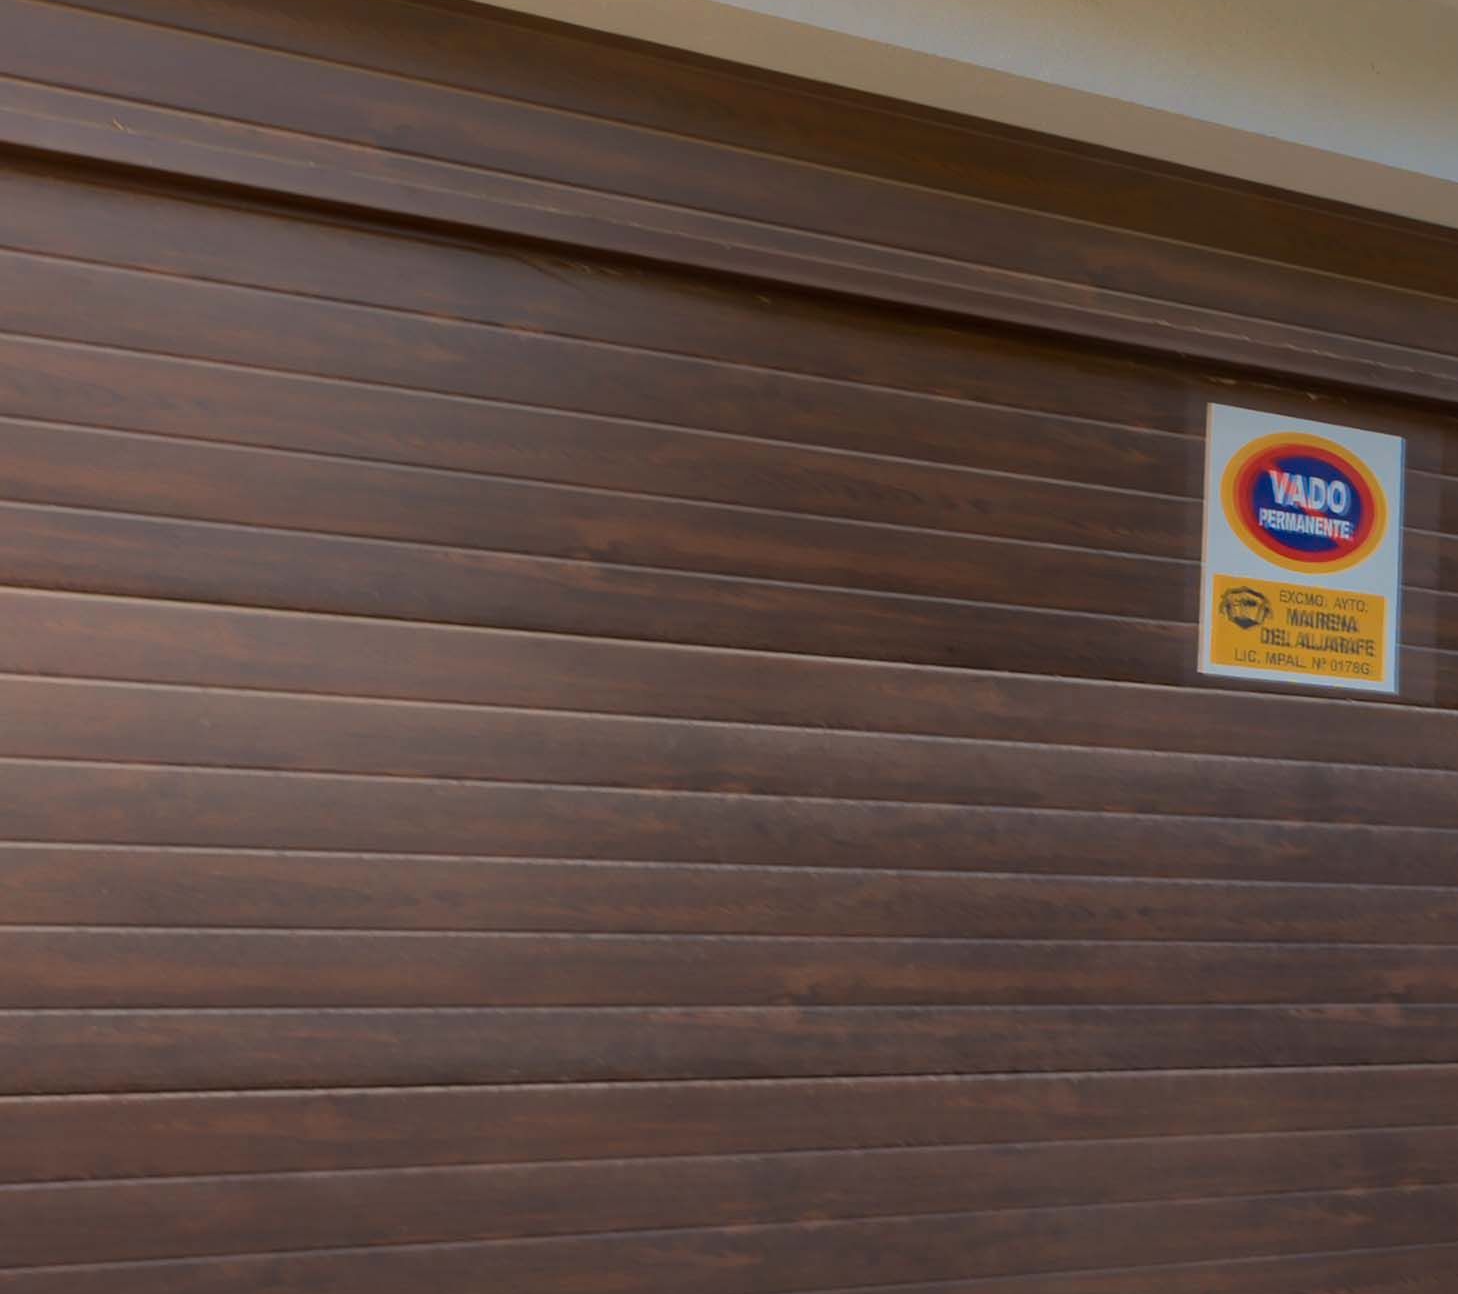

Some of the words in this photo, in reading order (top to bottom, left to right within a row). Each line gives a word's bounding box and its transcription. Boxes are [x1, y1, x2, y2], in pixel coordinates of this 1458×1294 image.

[1269, 470, 1350, 515] VADO
[1258, 507, 1353, 540] PERMANENTE
[1286, 608, 1358, 633] MAIRENA
[1233, 647, 1260, 664] LIC.
[1260, 627, 1290, 647] DEL
[1296, 632, 1376, 657] ALJARAFE
